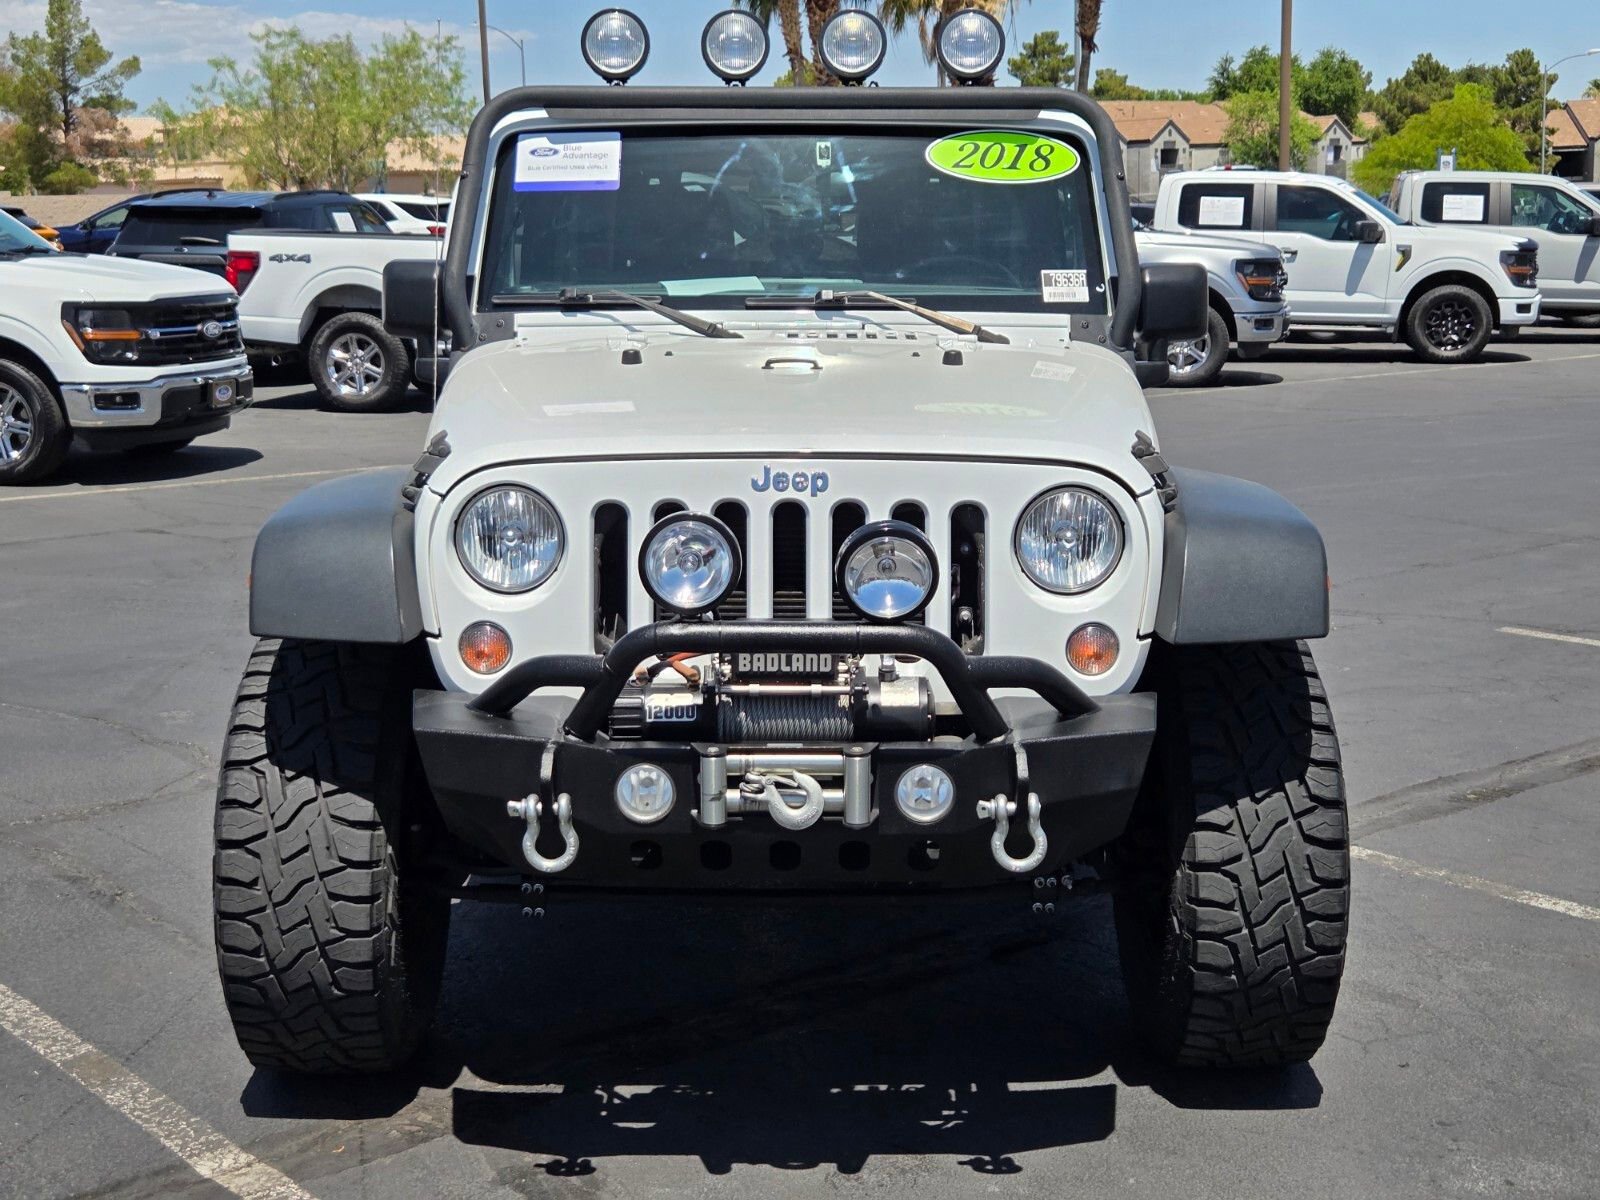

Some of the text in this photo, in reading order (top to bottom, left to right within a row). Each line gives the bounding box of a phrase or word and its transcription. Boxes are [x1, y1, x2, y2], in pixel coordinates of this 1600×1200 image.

[951, 142, 1055, 172] 2018
[751, 464, 829, 497] Jeep
[738, 653, 832, 672] BADLAND
[647, 704, 696, 719] 12000
